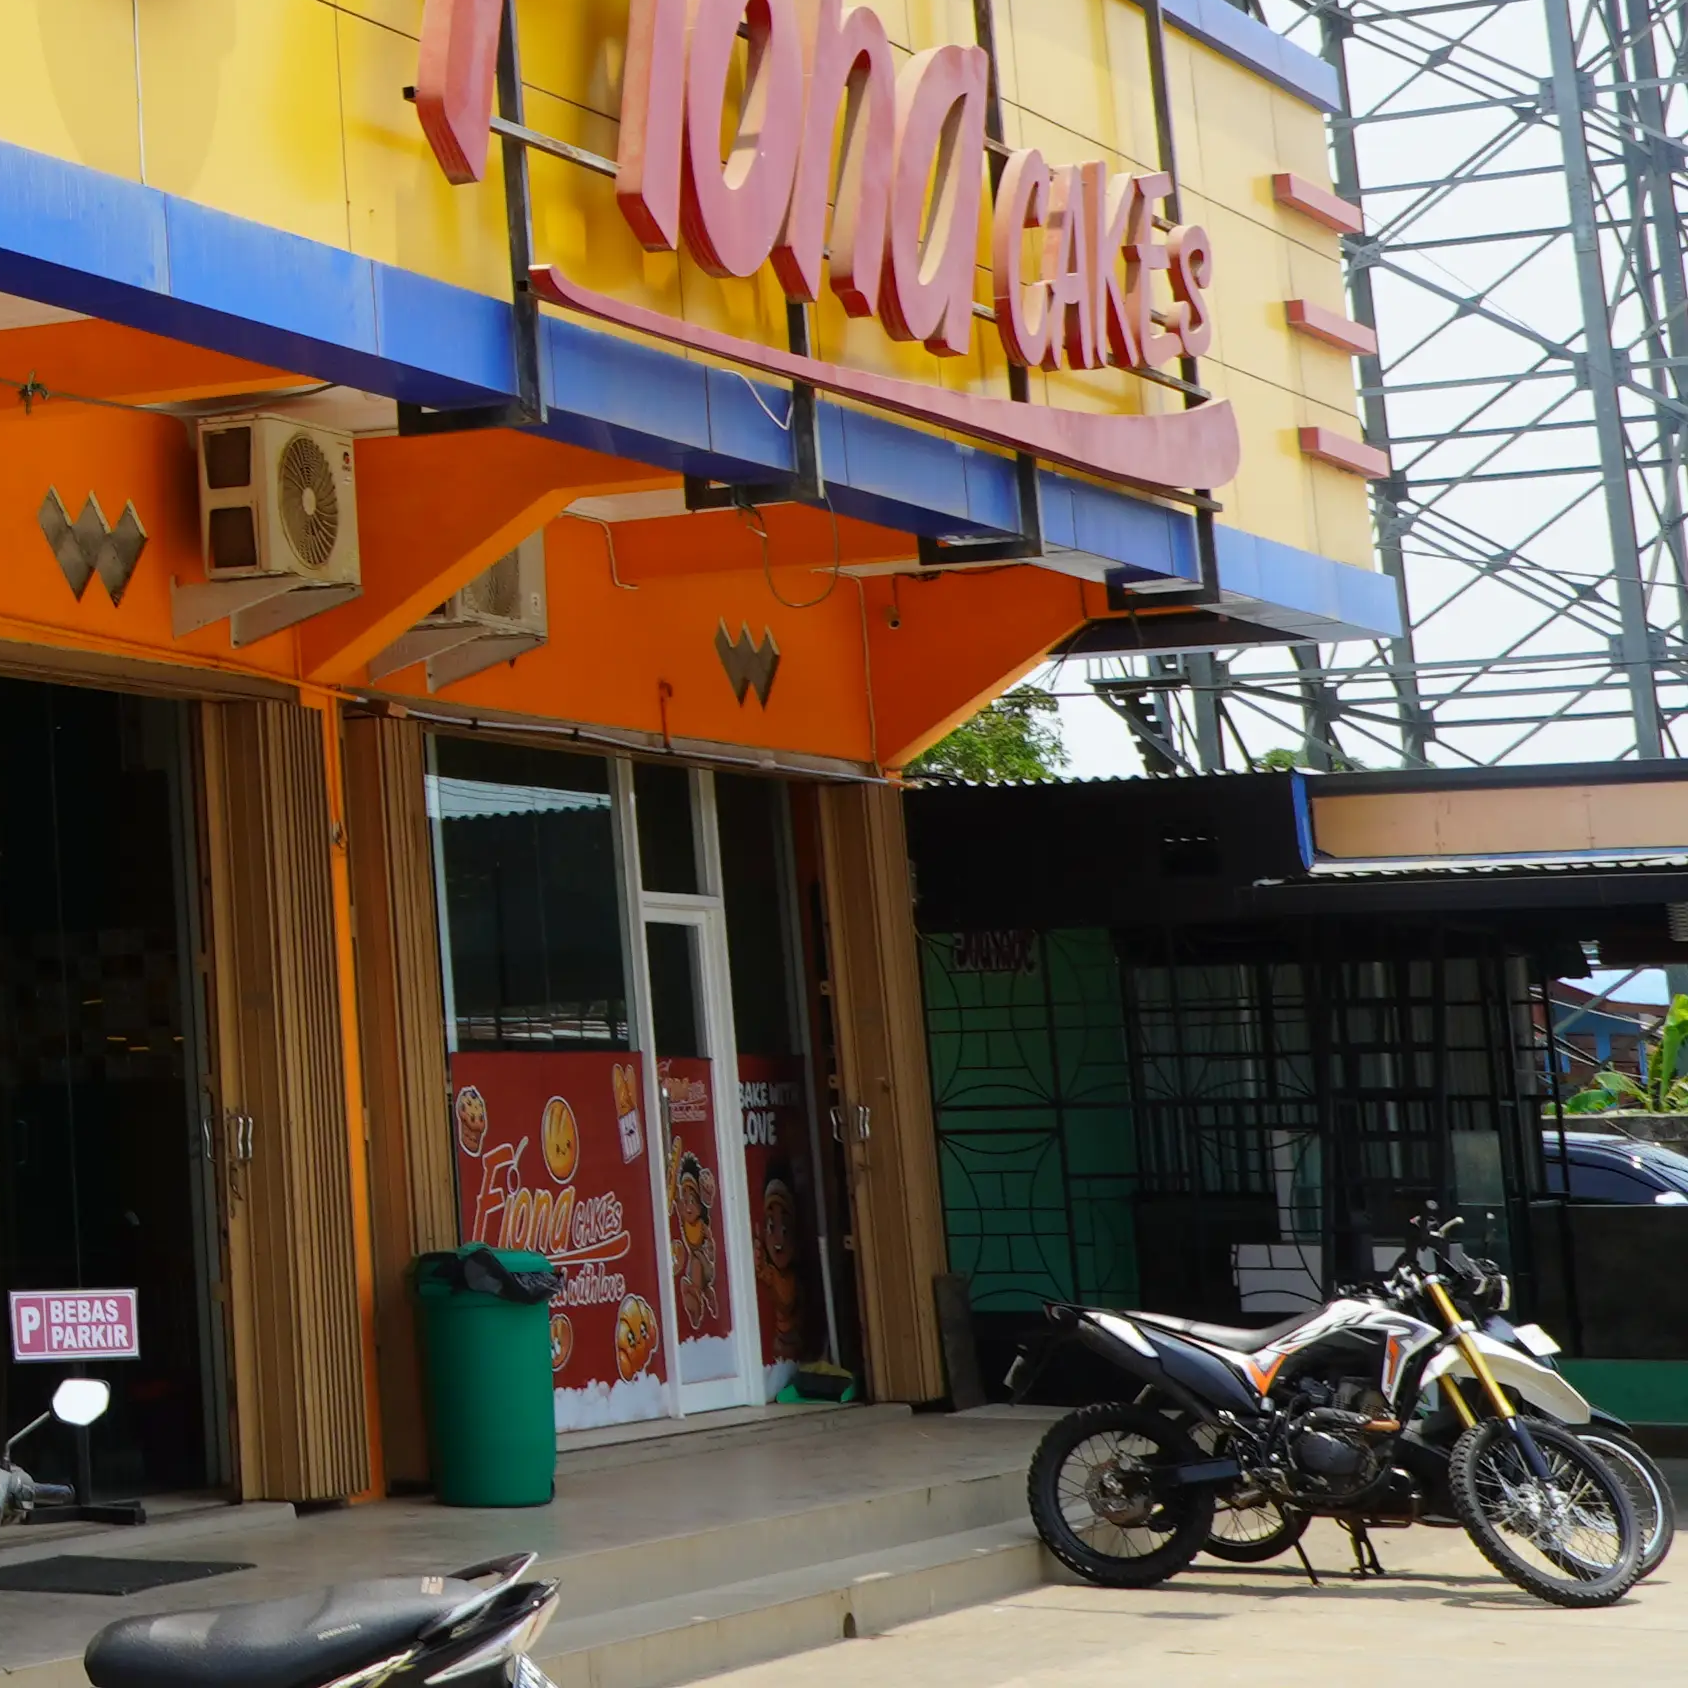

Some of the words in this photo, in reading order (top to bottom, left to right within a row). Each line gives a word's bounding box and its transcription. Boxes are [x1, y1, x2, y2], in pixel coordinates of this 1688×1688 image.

[472, 1142, 576, 1254] Fiona
[20, 1306, 41, 1344] P
[50, 1299, 119, 1323] BEBAS
[51, 1324, 129, 1349] PARKIR
